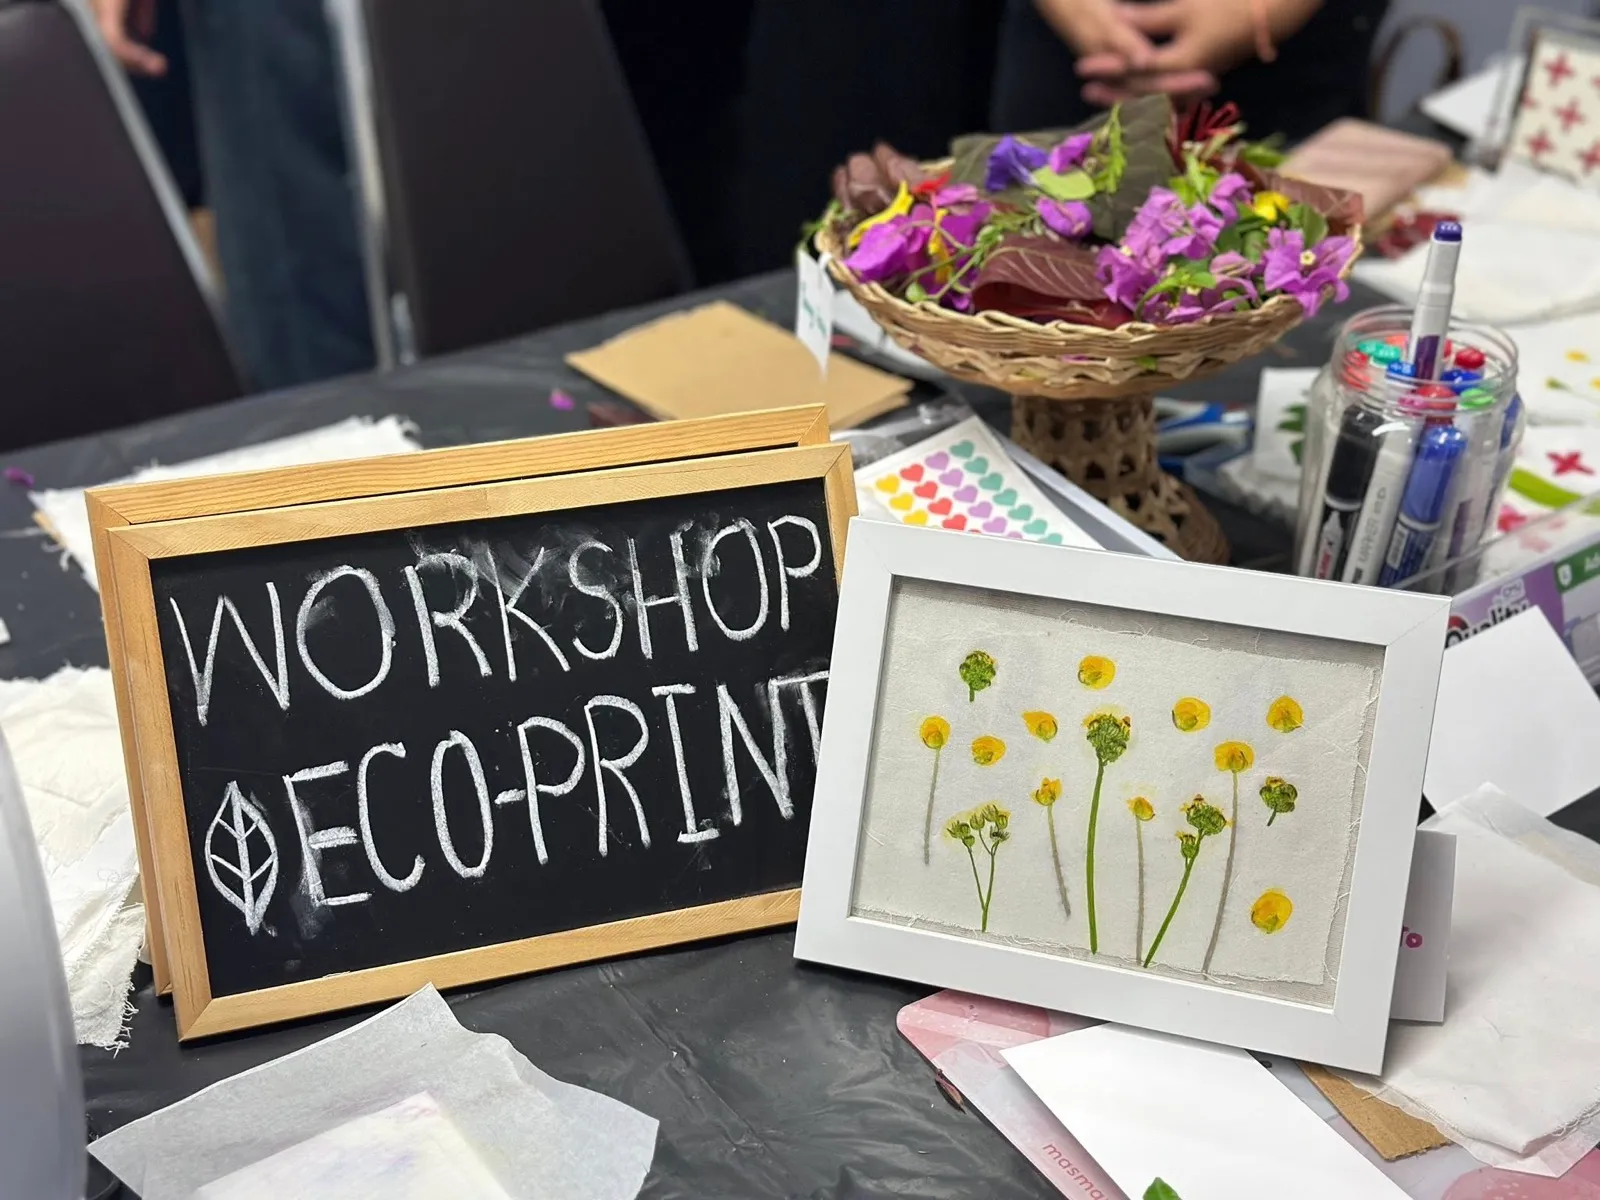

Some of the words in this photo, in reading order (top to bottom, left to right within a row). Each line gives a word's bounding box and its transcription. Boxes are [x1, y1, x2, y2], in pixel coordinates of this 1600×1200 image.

[170, 514, 822, 726] WORKSHOP
[283, 670, 829, 908] ECO-PRINT
[1043, 1144, 1109, 1200] masma
